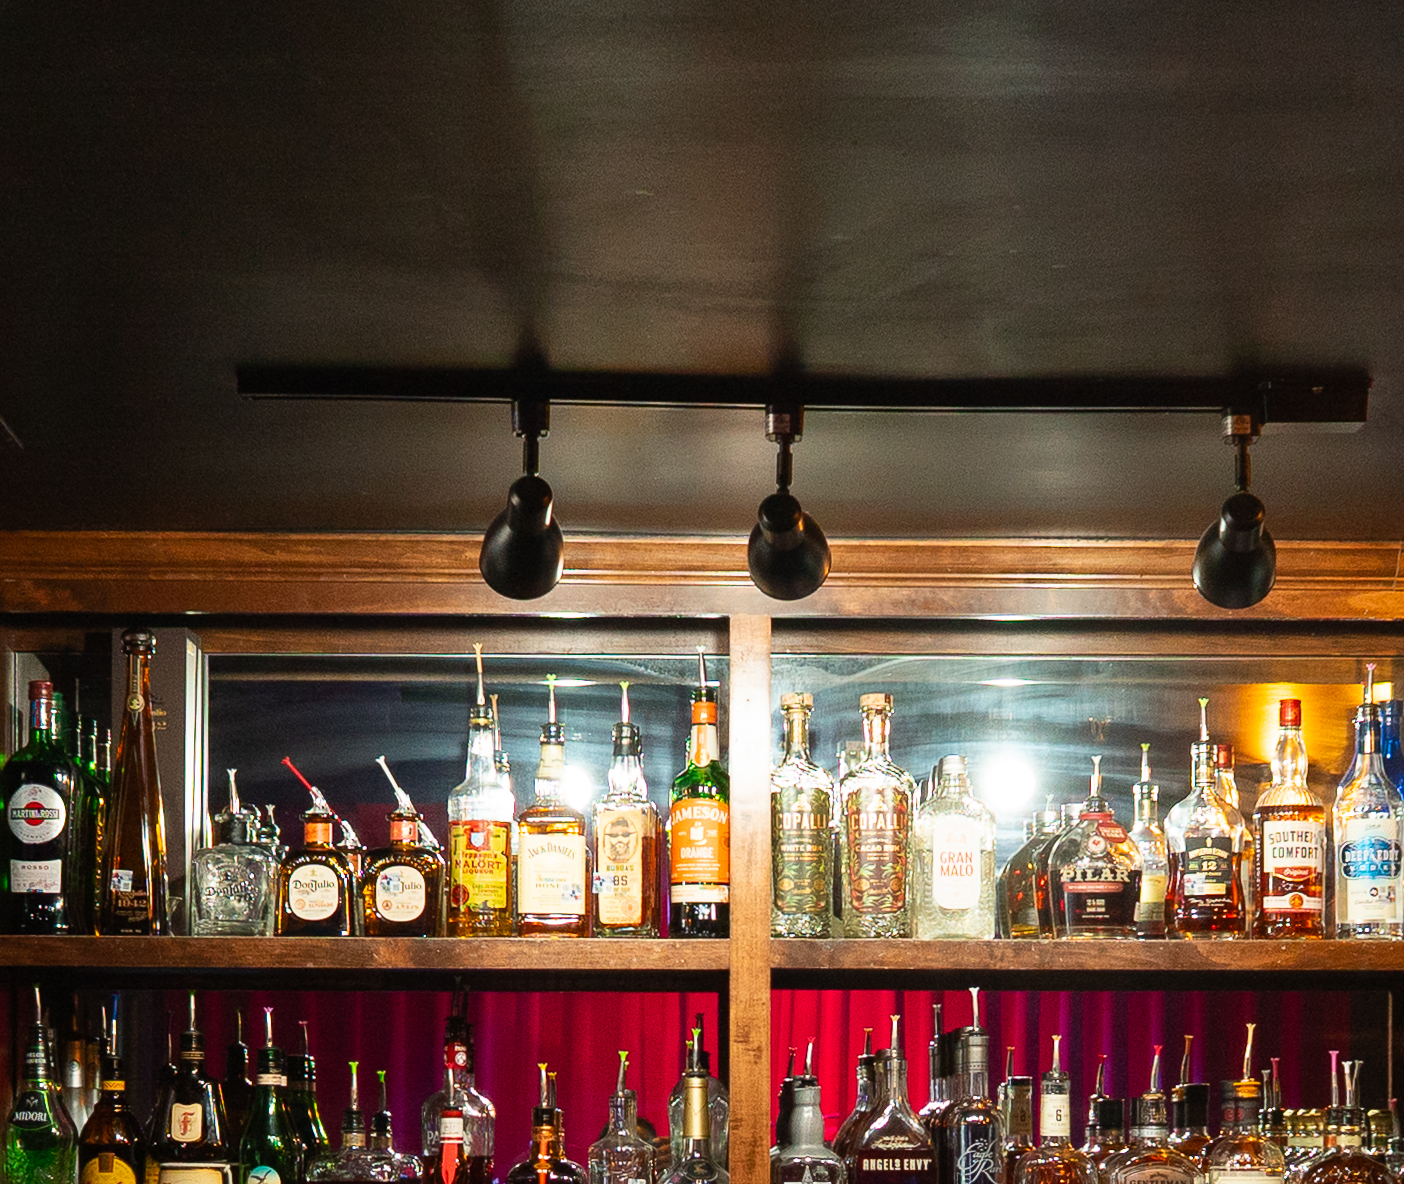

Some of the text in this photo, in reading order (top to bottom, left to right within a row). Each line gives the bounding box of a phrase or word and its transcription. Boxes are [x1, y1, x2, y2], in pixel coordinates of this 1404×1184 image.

[672, 806, 727, 825] JAMESON
[775, 812, 827, 830] COPALLI
[850, 812, 906, 830] COPALLI
[681, 847, 714, 859] ORANGE
[940, 852, 973, 864] GRAN
[1273, 846, 1317, 859] COMFORT
[1344, 850, 1369, 862] DEEP
[940, 864, 974, 877] MALO
[1201, 859, 1217, 872] 12
[1059, 868, 1130, 883] PILAR
[14, 1110, 48, 1123] MIDORI
[1054, 1109, 1063, 1122] 6
[903, 1158, 930, 1172] ENVY
